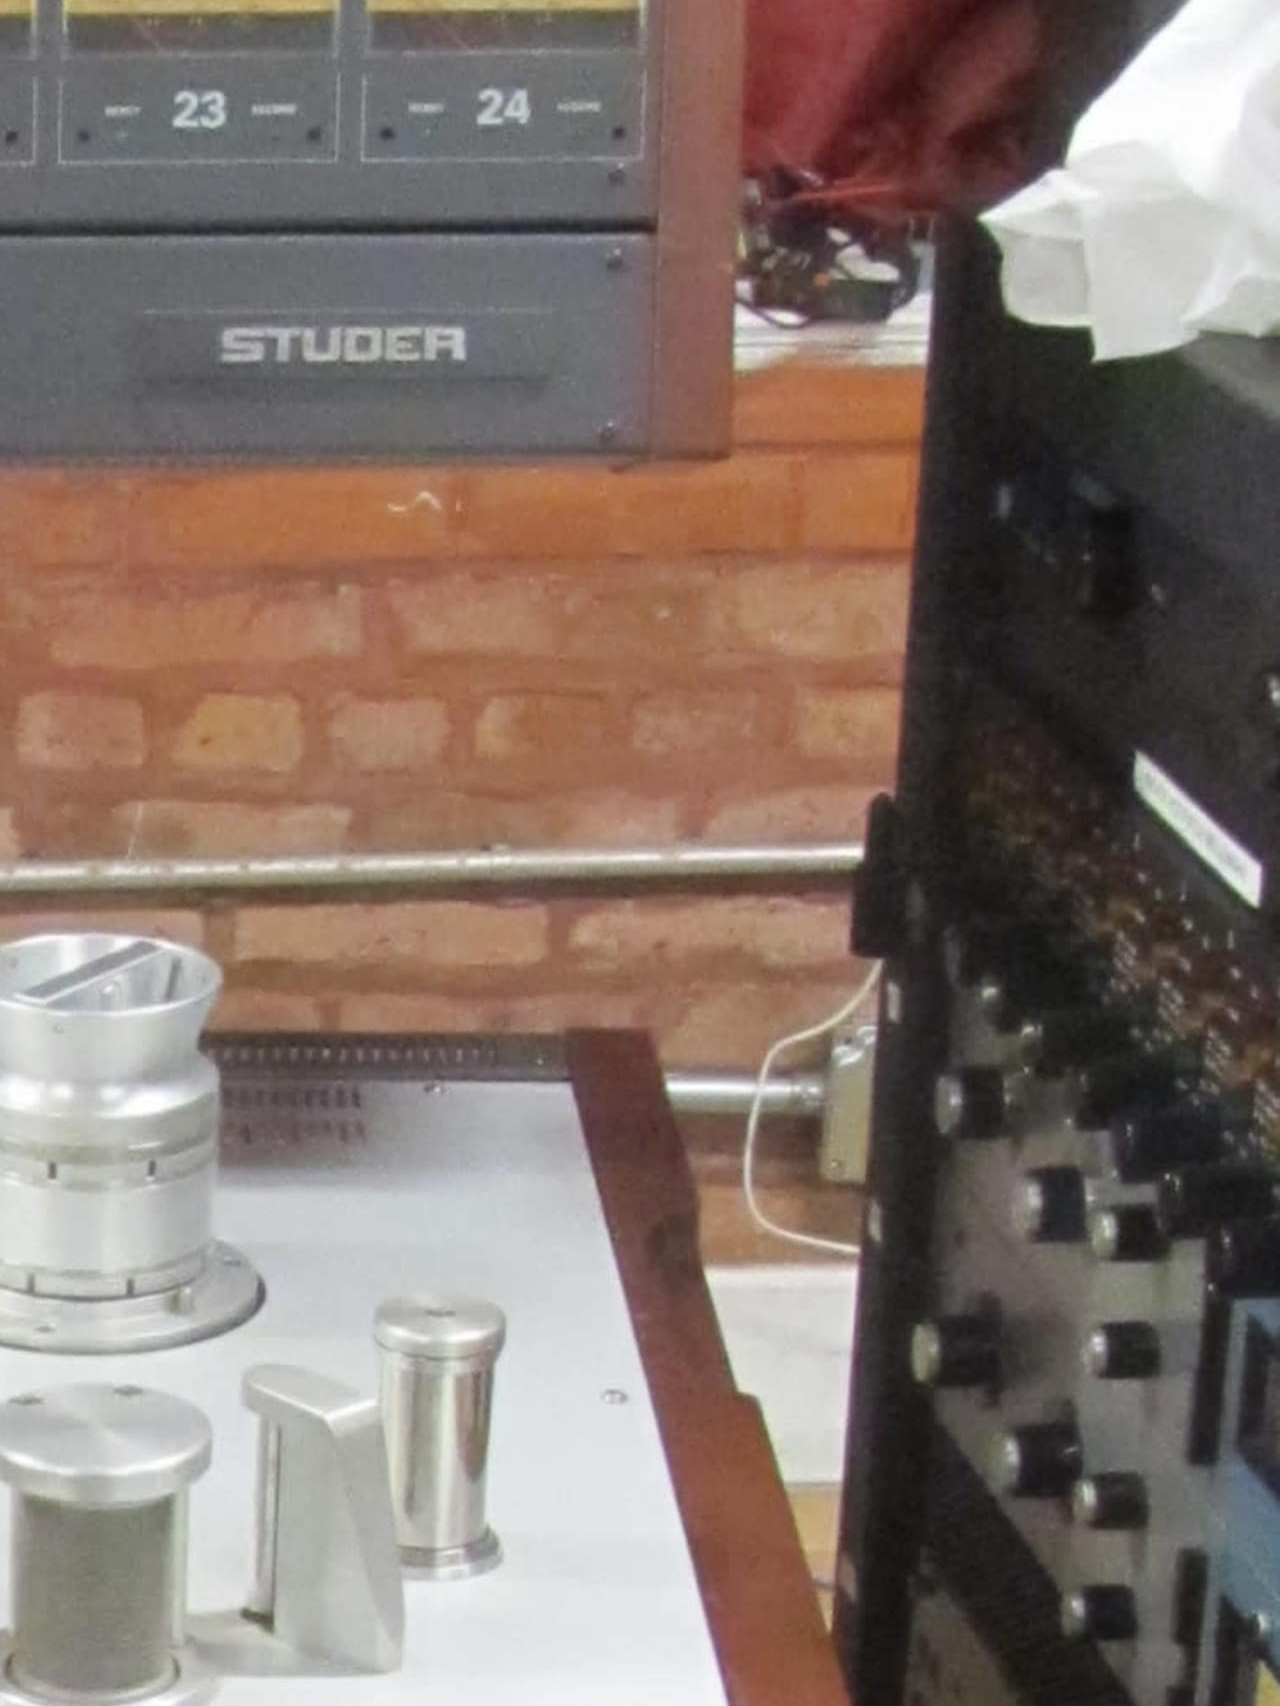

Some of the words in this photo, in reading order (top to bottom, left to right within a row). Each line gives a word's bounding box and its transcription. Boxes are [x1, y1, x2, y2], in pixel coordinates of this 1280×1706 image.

[171, 89, 228, 130] 23
[476, 87, 532, 126] 24
[220, 326, 467, 362] STUDER
